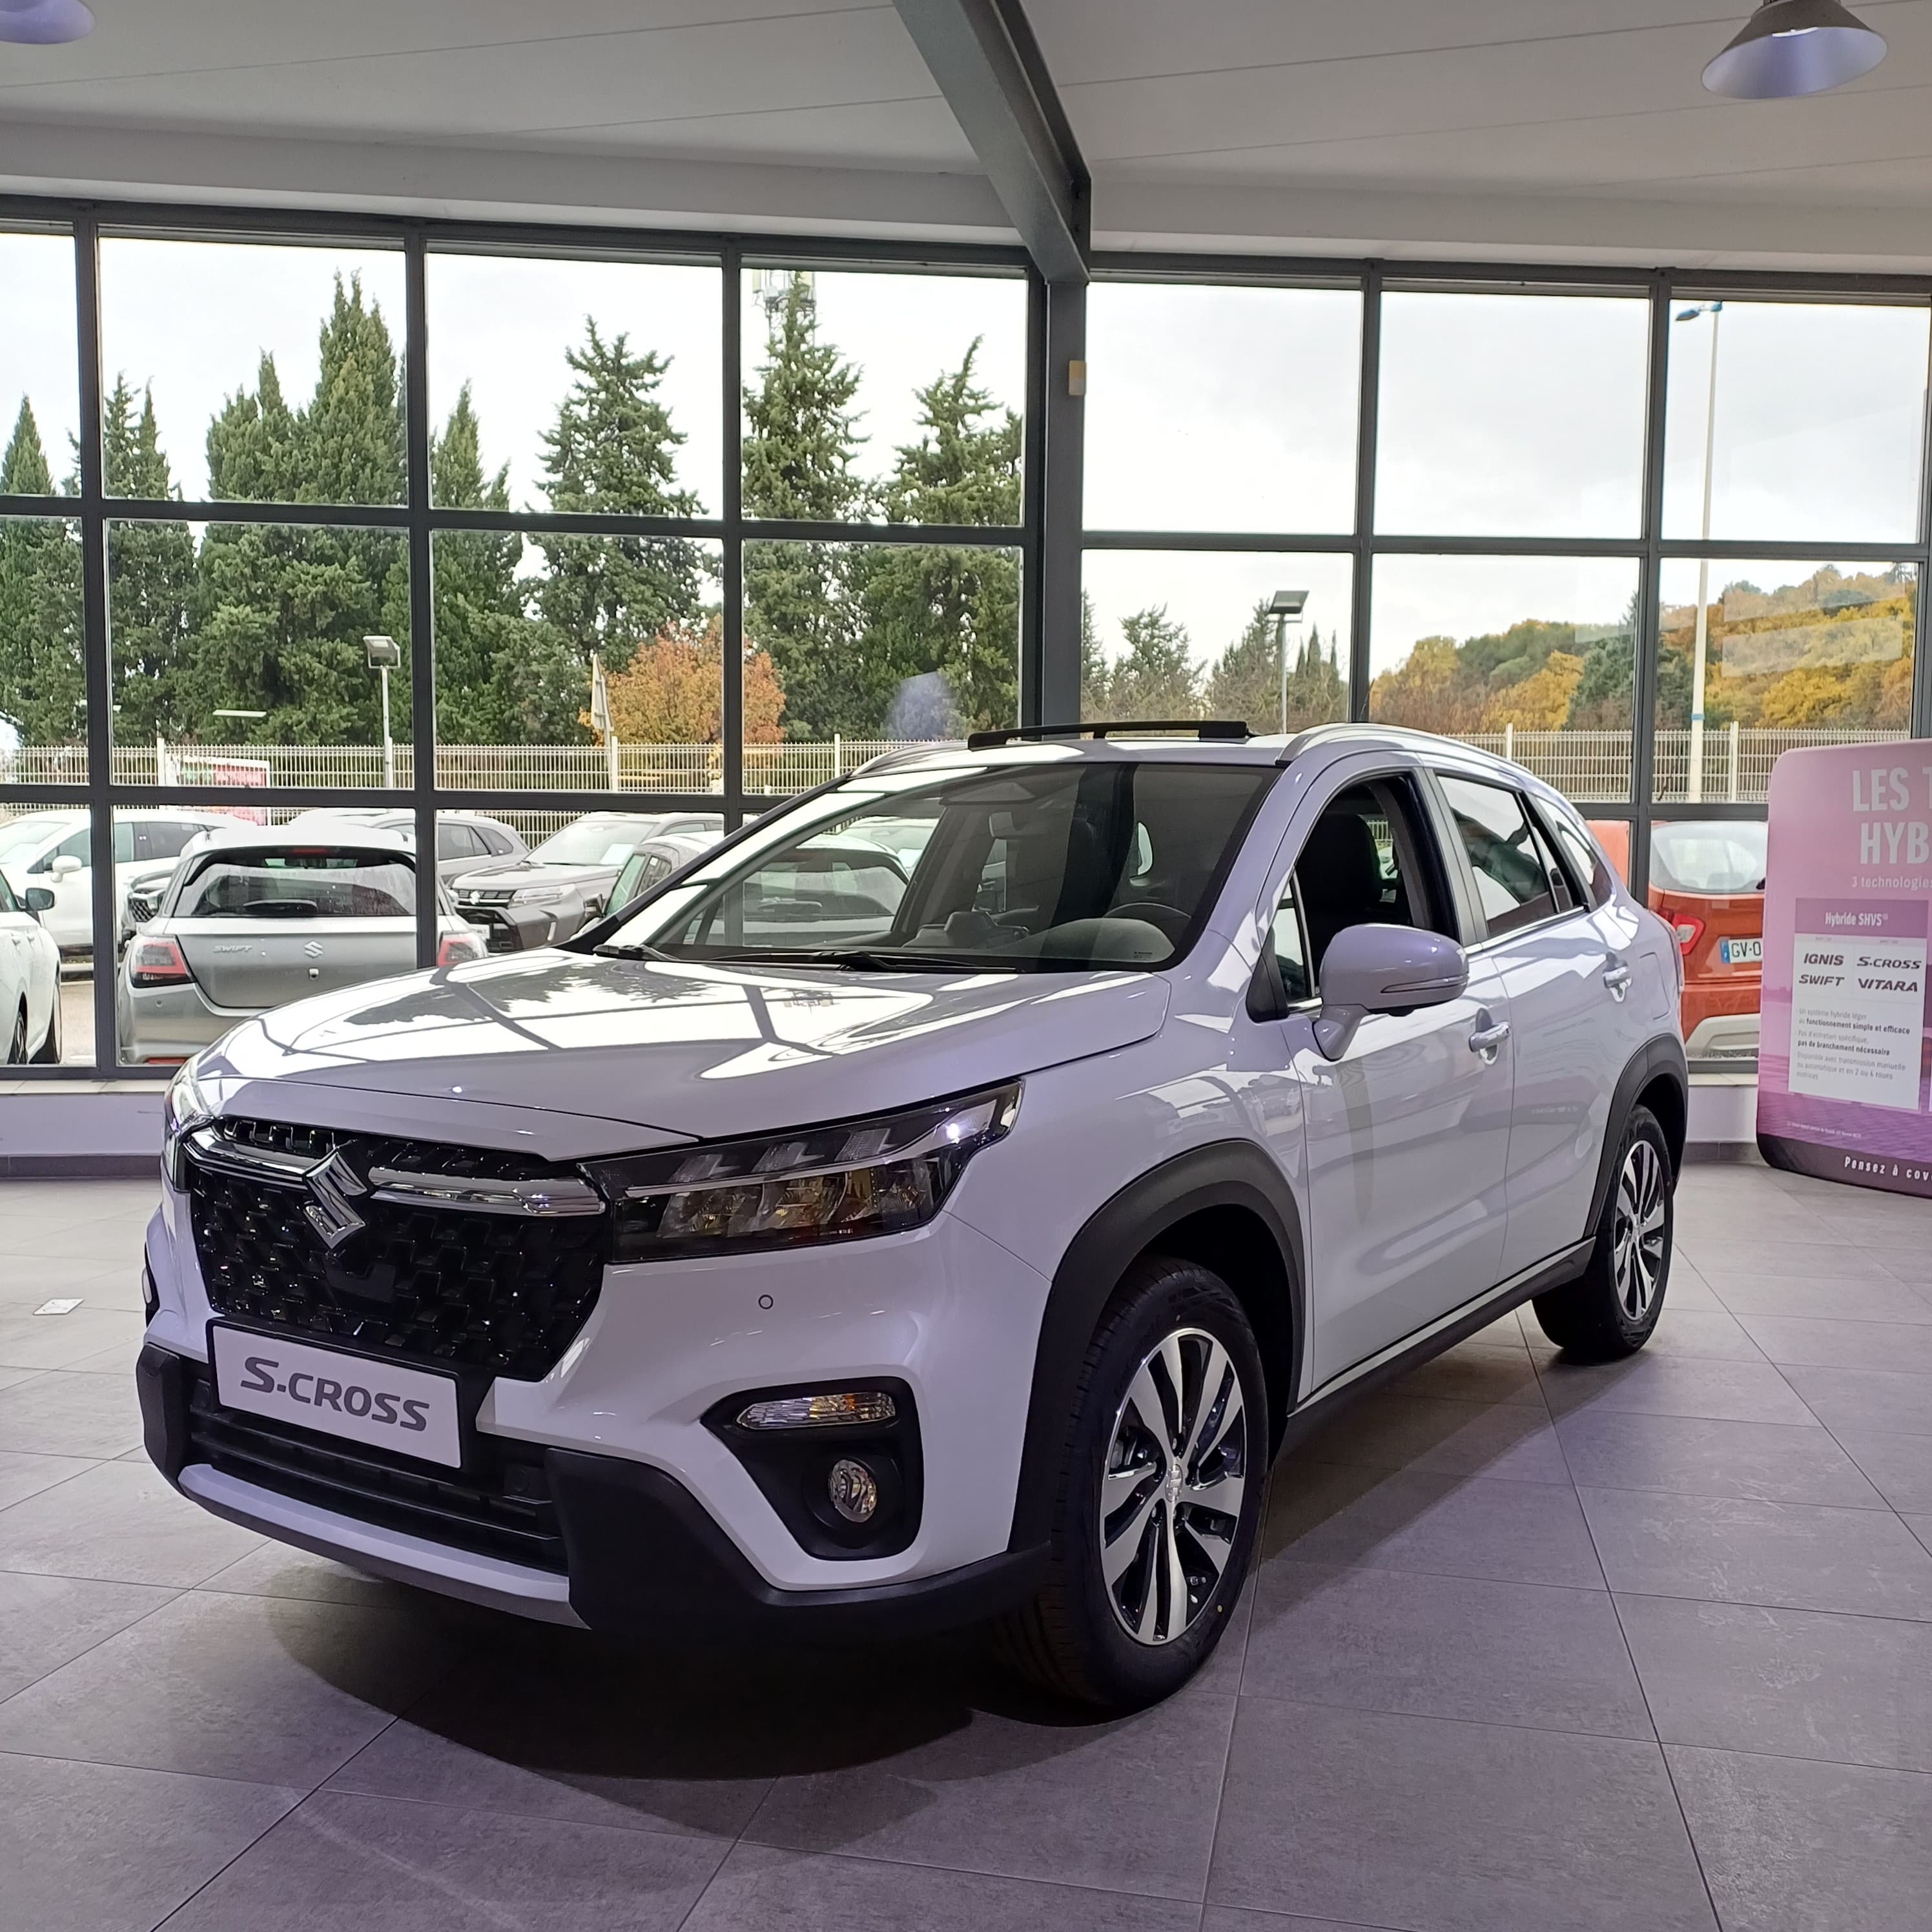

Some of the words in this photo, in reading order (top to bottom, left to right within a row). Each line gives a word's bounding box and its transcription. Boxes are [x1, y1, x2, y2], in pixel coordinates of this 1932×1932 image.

[1853, 766, 1910, 812] LES
[1860, 821, 1930, 865] HYB
[1851, 875, 1858, 888] 3
[1825, 912, 1856, 928] Hybride
[212, 945, 253, 953] SWIFT
[1804, 953, 1844, 966] IGNIS
[1856, 956, 1922, 970] S.CROSS
[1798, 974, 1845, 987] SWIFT
[1858, 978, 1918, 992] VITARA
[1830, 1010, 1851, 1019] hybride
[1806, 1017, 1851, 1028] fonctionnement
[1853, 1022, 1873, 1032] simple
[1883, 1025, 1911, 1034] efficace
[1816, 1041, 1855, 1052] branchement
[1856, 1045, 1890, 1056] nécessaire
[1838, 1057, 1875, 1067] transmission
[1876, 1062, 1906, 1071] manuelle
[1805, 1064, 1837, 1073] automatique
[1855, 1068, 1859, 1076] 2
[1875, 1071, 1893, 1080] roues
[1844, 1155, 1886, 1175] Pensez
[1892, 1163, 1899, 1177] à
[1906, 1168, 1932, 1181] cov
[240, 1356, 431, 1432] S.CROSS
